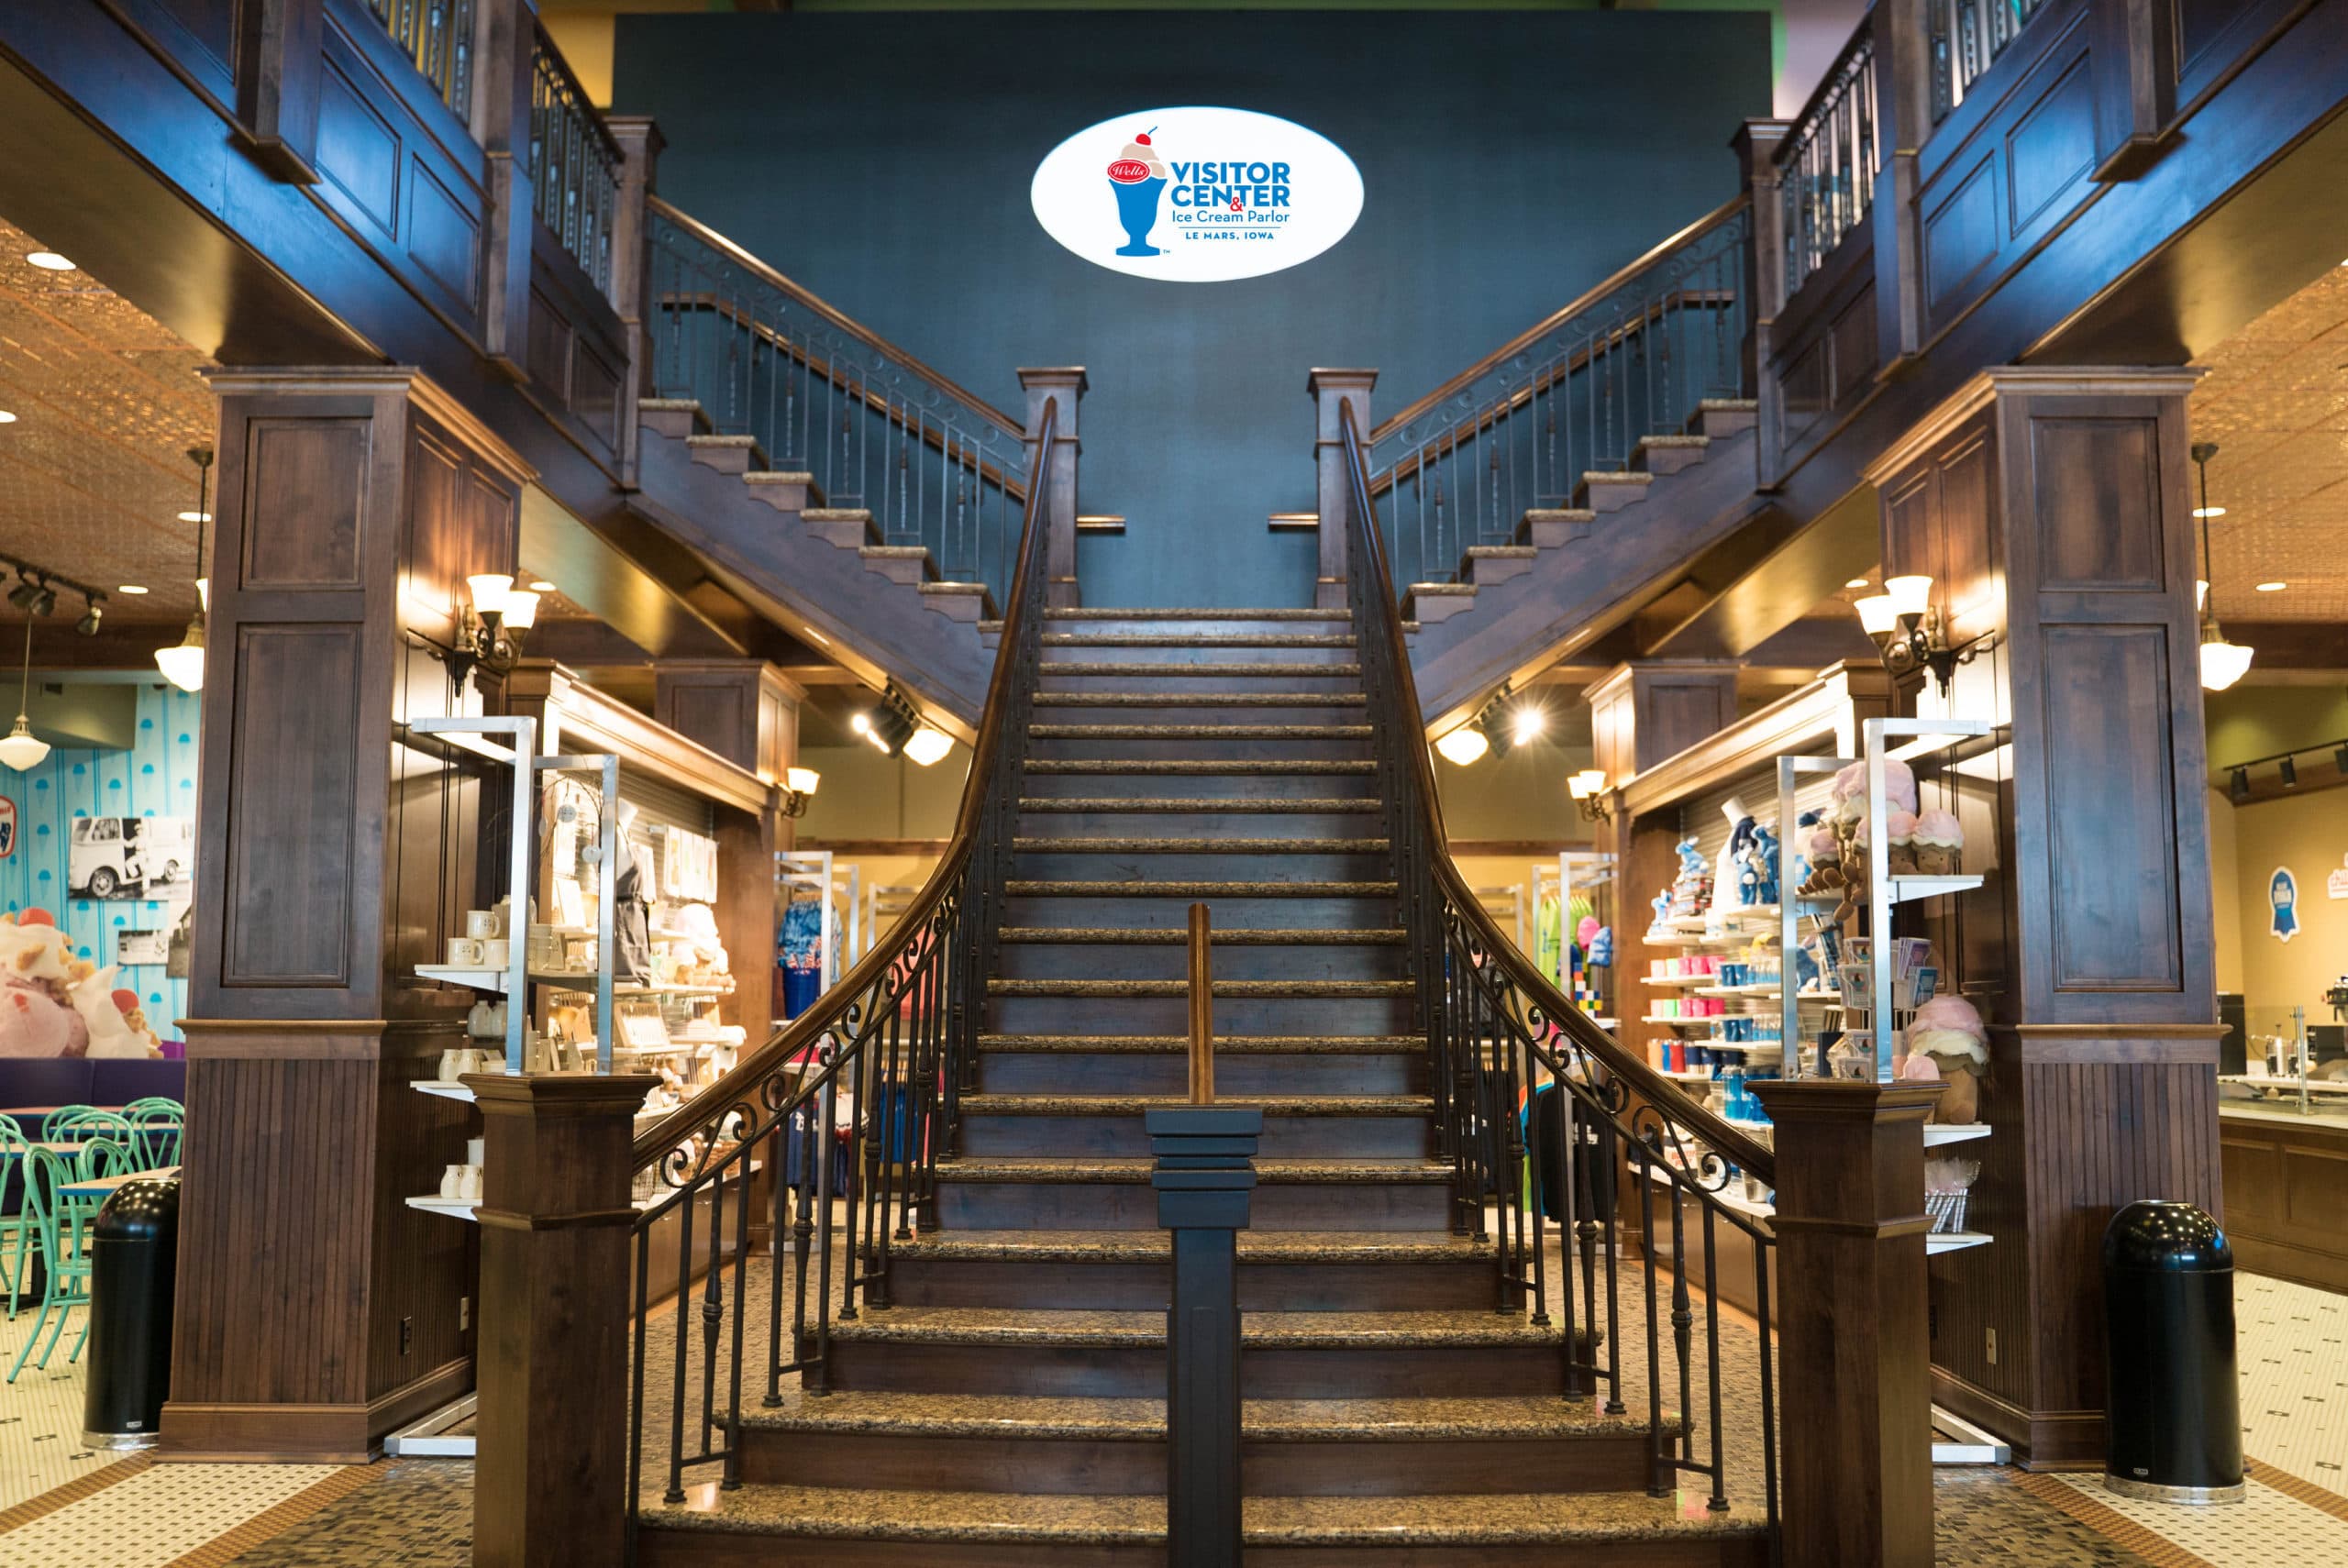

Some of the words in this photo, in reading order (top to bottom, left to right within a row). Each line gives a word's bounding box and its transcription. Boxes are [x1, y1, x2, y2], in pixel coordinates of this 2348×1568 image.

[1112, 165, 1146, 176] Wells
[1170, 161, 1290, 183] VISITOR
[1171, 185, 1290, 206] CENTER
[1230, 196, 1243, 212] &
[1172, 210, 1192, 223] Ice
[1197, 210, 1243, 223] Cream
[1248, 209, 1290, 223] Parlor
[1186, 232, 1199, 240] LE
[1203, 232, 1239, 241] MARS,
[1245, 232, 1275, 240] IOWA
